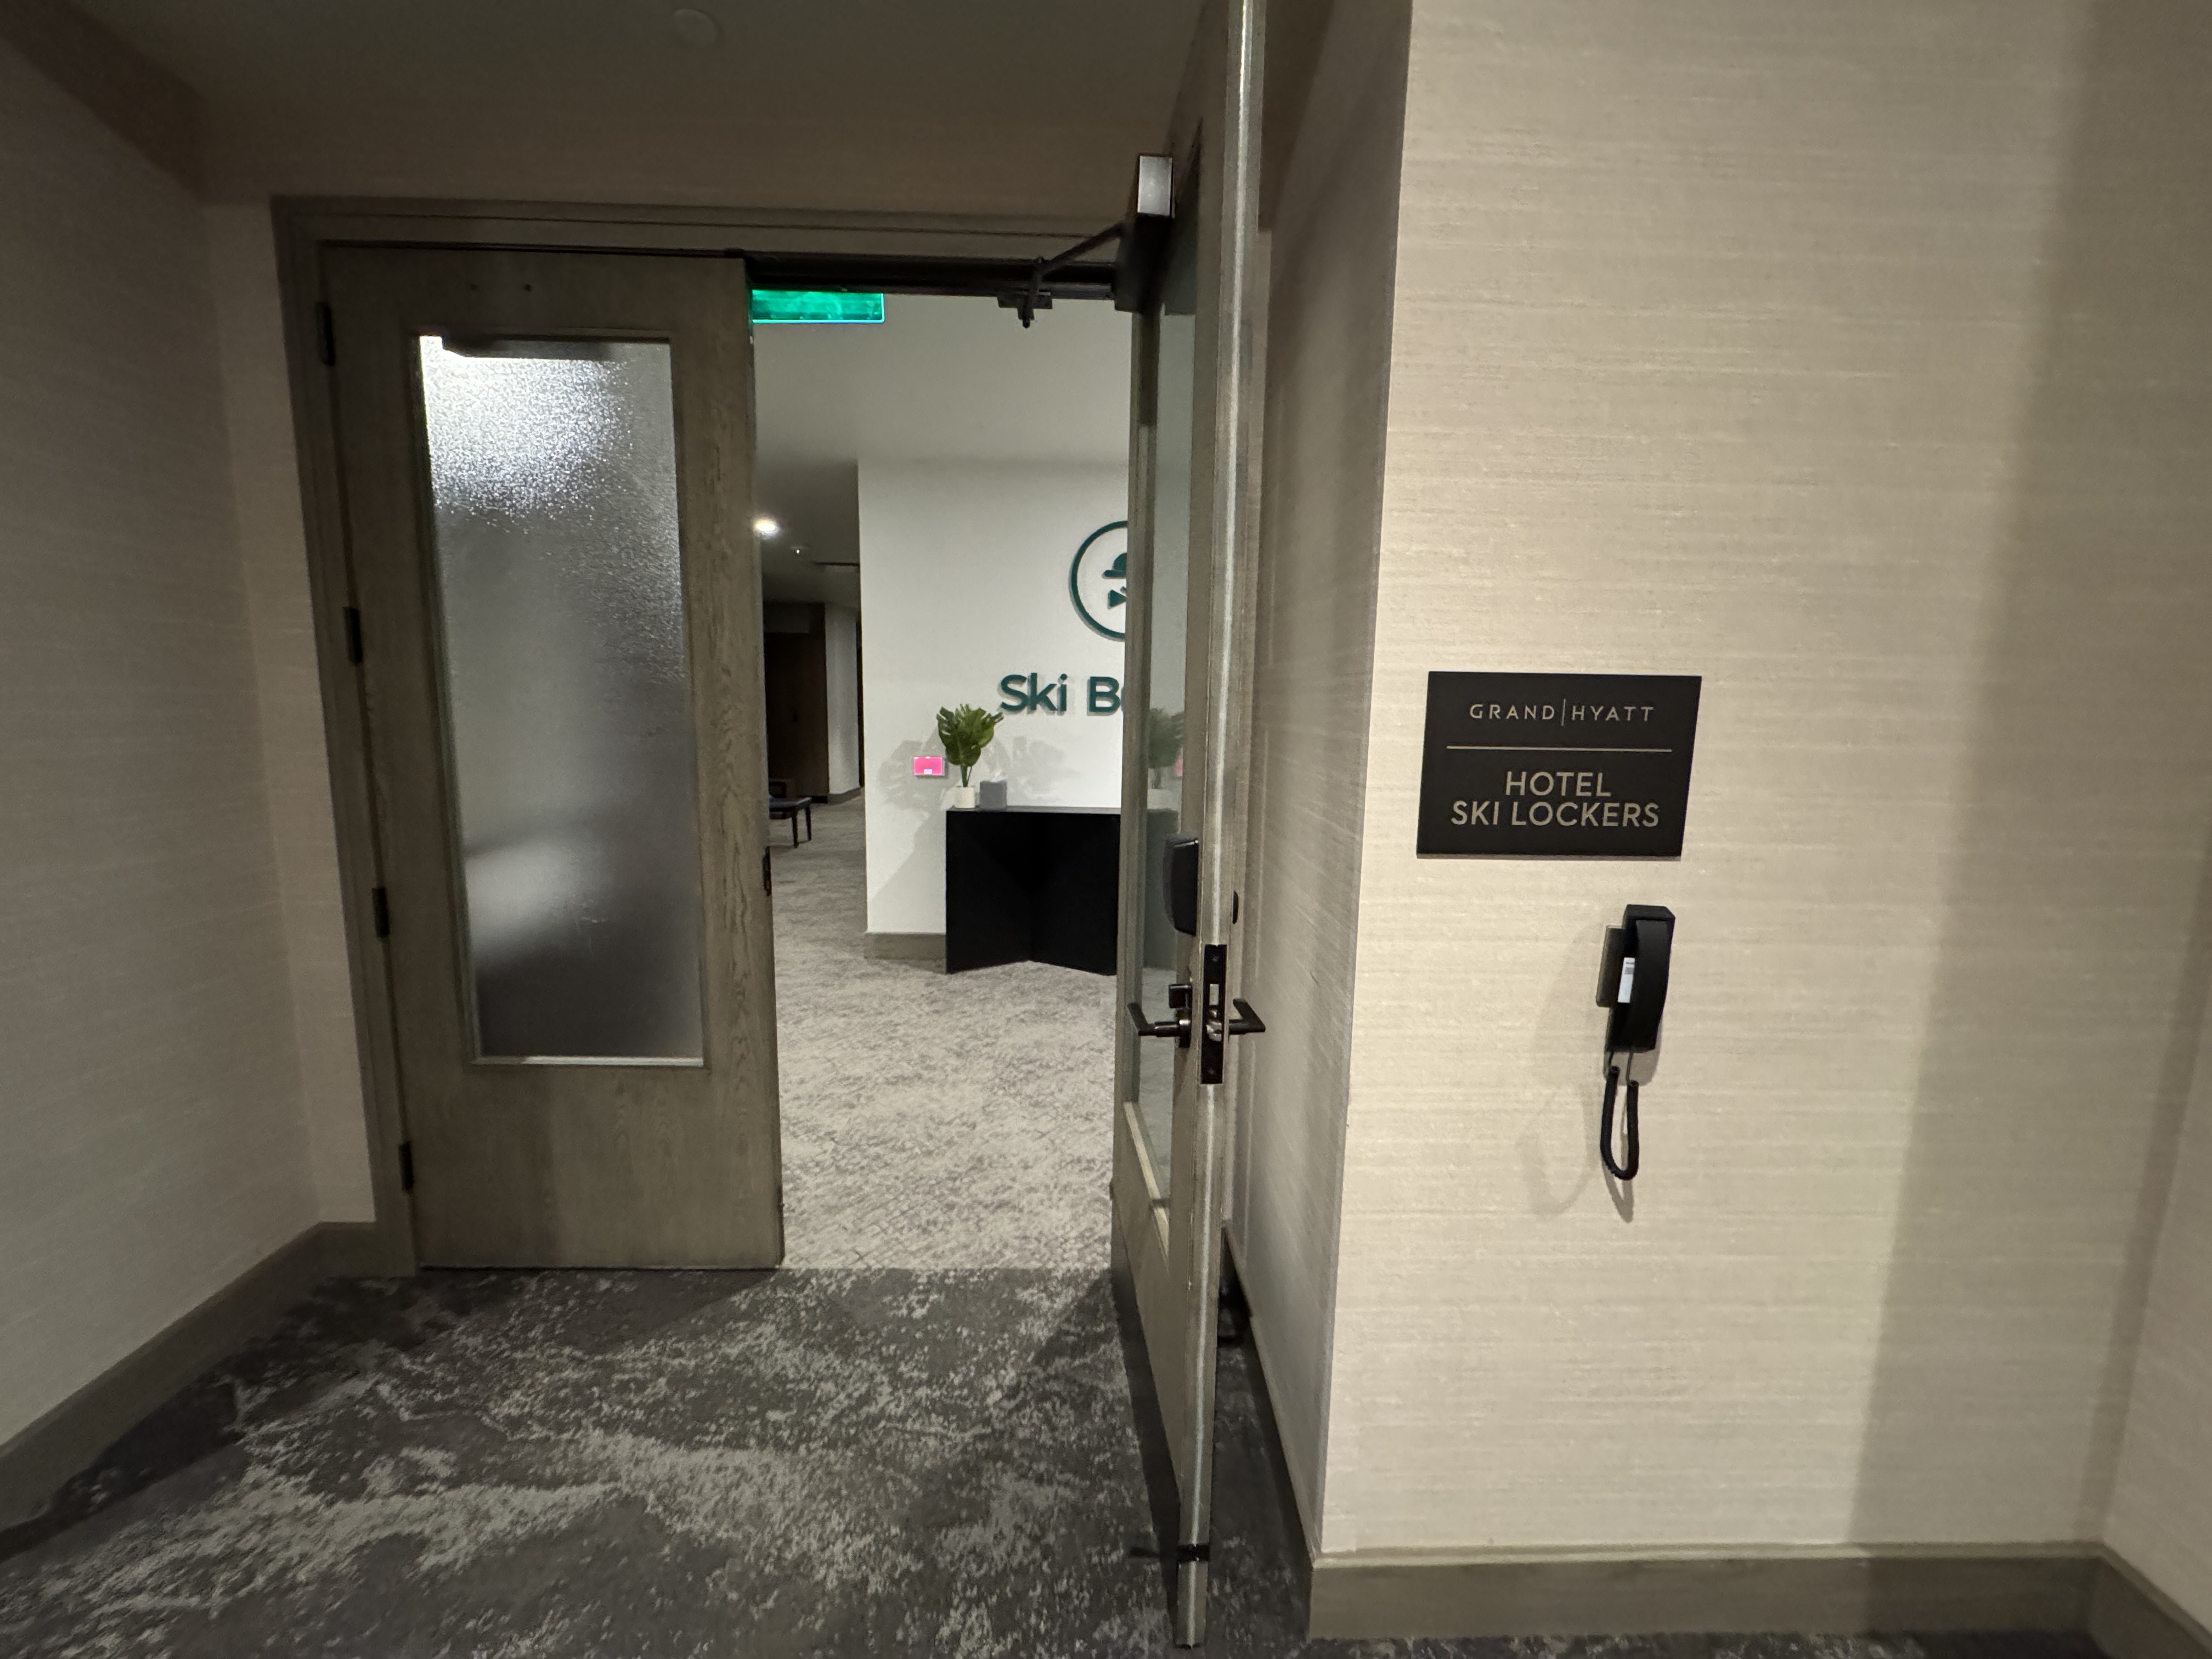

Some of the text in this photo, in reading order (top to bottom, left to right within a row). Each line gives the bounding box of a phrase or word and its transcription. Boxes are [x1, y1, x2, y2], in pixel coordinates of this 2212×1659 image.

[1001, 673, 1125, 713] Ski B
[1469, 704, 1654, 722] GRAND HYATT
[1505, 771, 1611, 797] HOTEL
[1451, 800, 1660, 827] SKI LOCKERS
